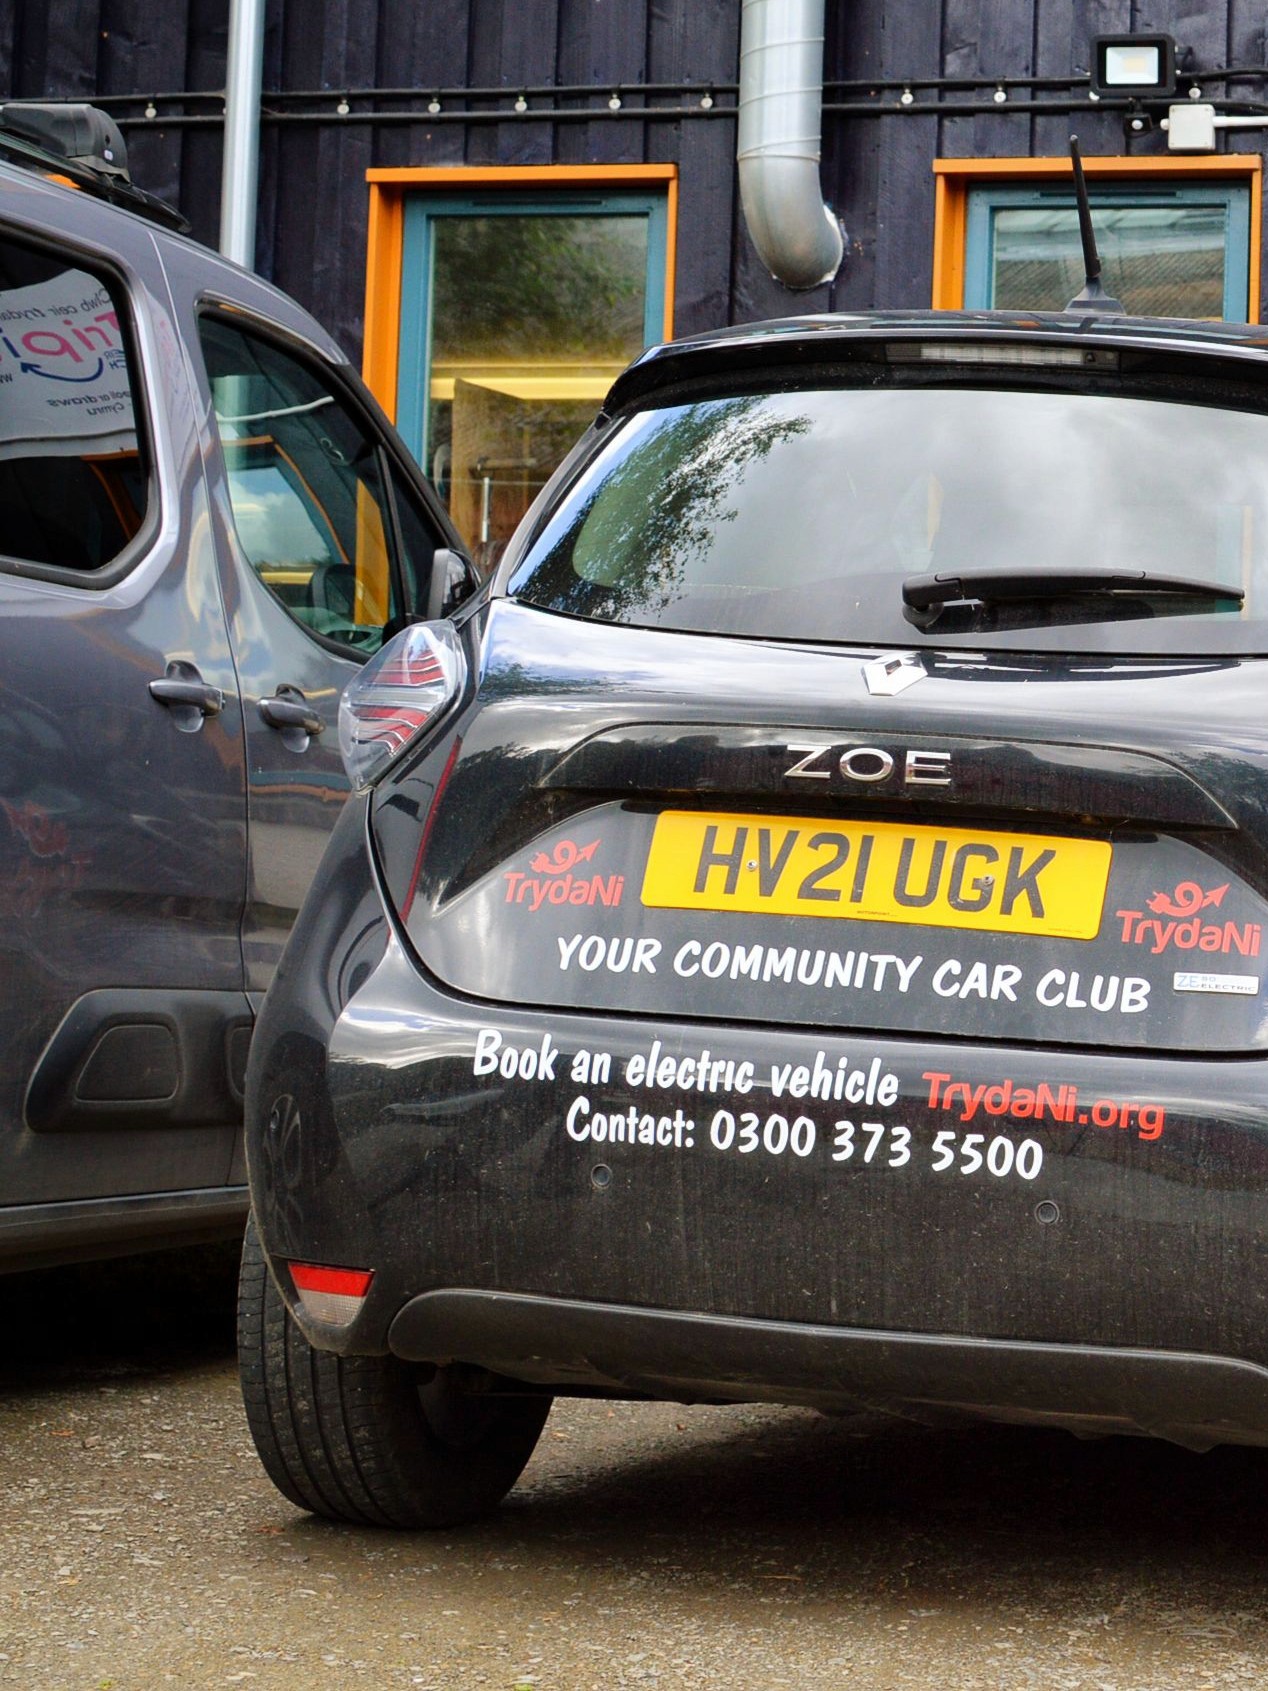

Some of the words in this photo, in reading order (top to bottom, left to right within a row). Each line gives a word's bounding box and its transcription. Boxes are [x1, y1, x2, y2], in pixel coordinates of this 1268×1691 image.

[784, 744, 952, 786] ZOE
[503, 871, 625, 912] TrydaNi
[692, 824, 876, 904] HV21
[893, 837, 1056, 919] UGK
[1115, 909, 1262, 958] TrydaNi
[557, 933, 663, 975] YOUR
[673, 939, 924, 993] COMMUNITY
[931, 958, 1023, 1002] CAR
[1035, 968, 1152, 1014] CLUB
[1200, 983, 1257, 993] ELECTRIC
[472, 1029, 559, 1081] Book
[570, 1048, 612, 1085] an
[624, 1039, 755, 1095] electric
[770, 1050, 900, 1107] vehicle
[921, 1071, 1166, 1141] TrydaNi.org
[565, 1094, 696, 1149] Contact:
[709, 1108, 817, 1158] 0300
[831, 1120, 912, 1168] 373
[930, 1130, 1044, 1181] 5500
